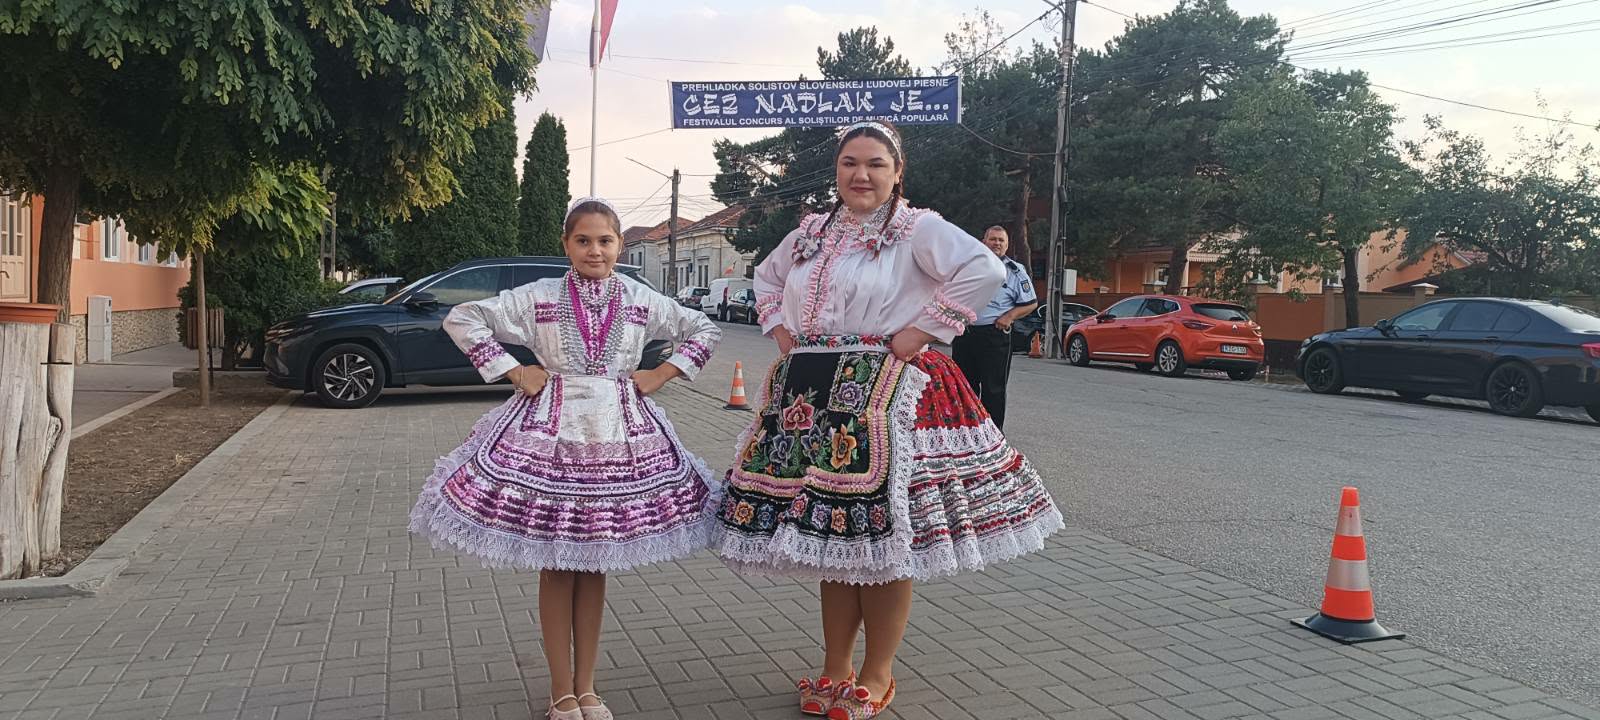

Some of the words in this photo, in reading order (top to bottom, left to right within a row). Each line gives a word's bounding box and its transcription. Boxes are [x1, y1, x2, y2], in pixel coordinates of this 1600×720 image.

[682, 83, 746, 92] PREHLIADKA
[748, 82, 797, 91] SOLISTOV
[799, 80, 864, 90] SLOVENSKEJ
[914, 78, 949, 87] PIESNE
[683, 93, 738, 115] CEZ
[755, 91, 875, 114] NADLAK
[683, 118, 737, 126] FESTIVALUL
[739, 117, 783, 125] CONCURS
[785, 117, 796, 125] AL
[901, 113, 949, 122] POPULARĂ
